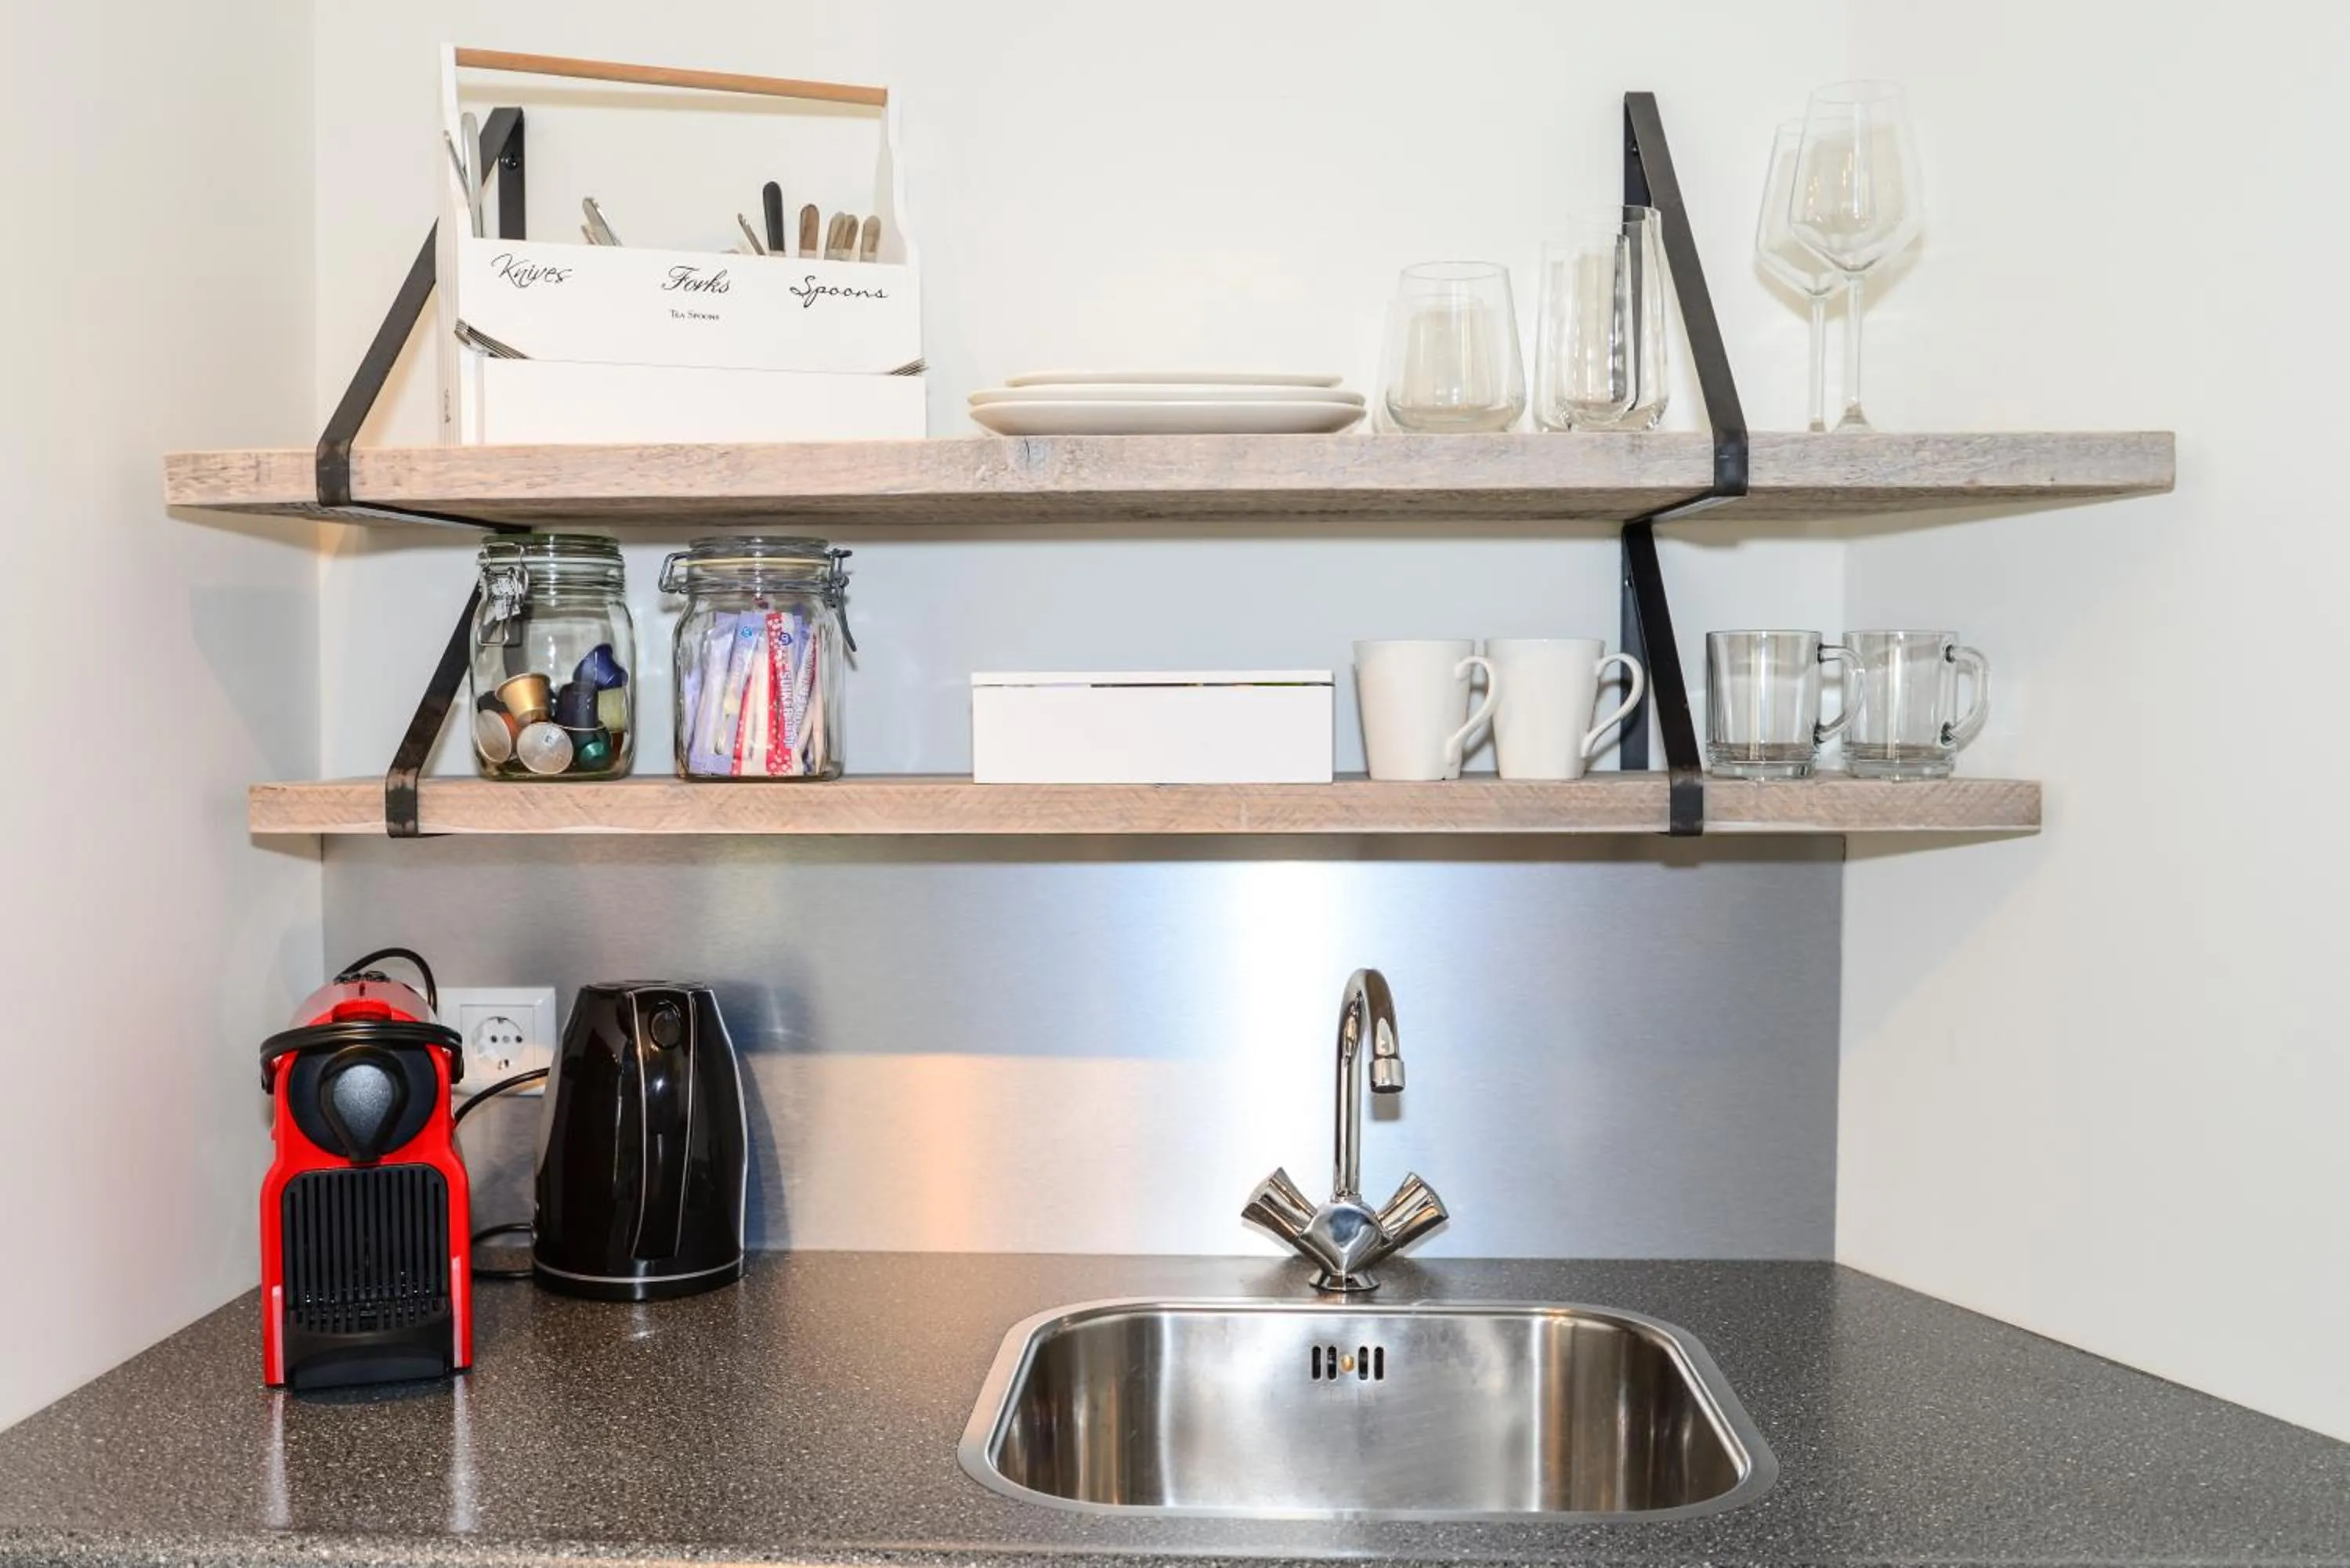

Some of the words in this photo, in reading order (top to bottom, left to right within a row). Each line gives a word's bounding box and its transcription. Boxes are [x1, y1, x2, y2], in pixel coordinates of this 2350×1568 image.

[490, 253, 573, 288] Knives
[661, 265, 732, 294] Forks
[788, 275, 889, 308] Spoons
